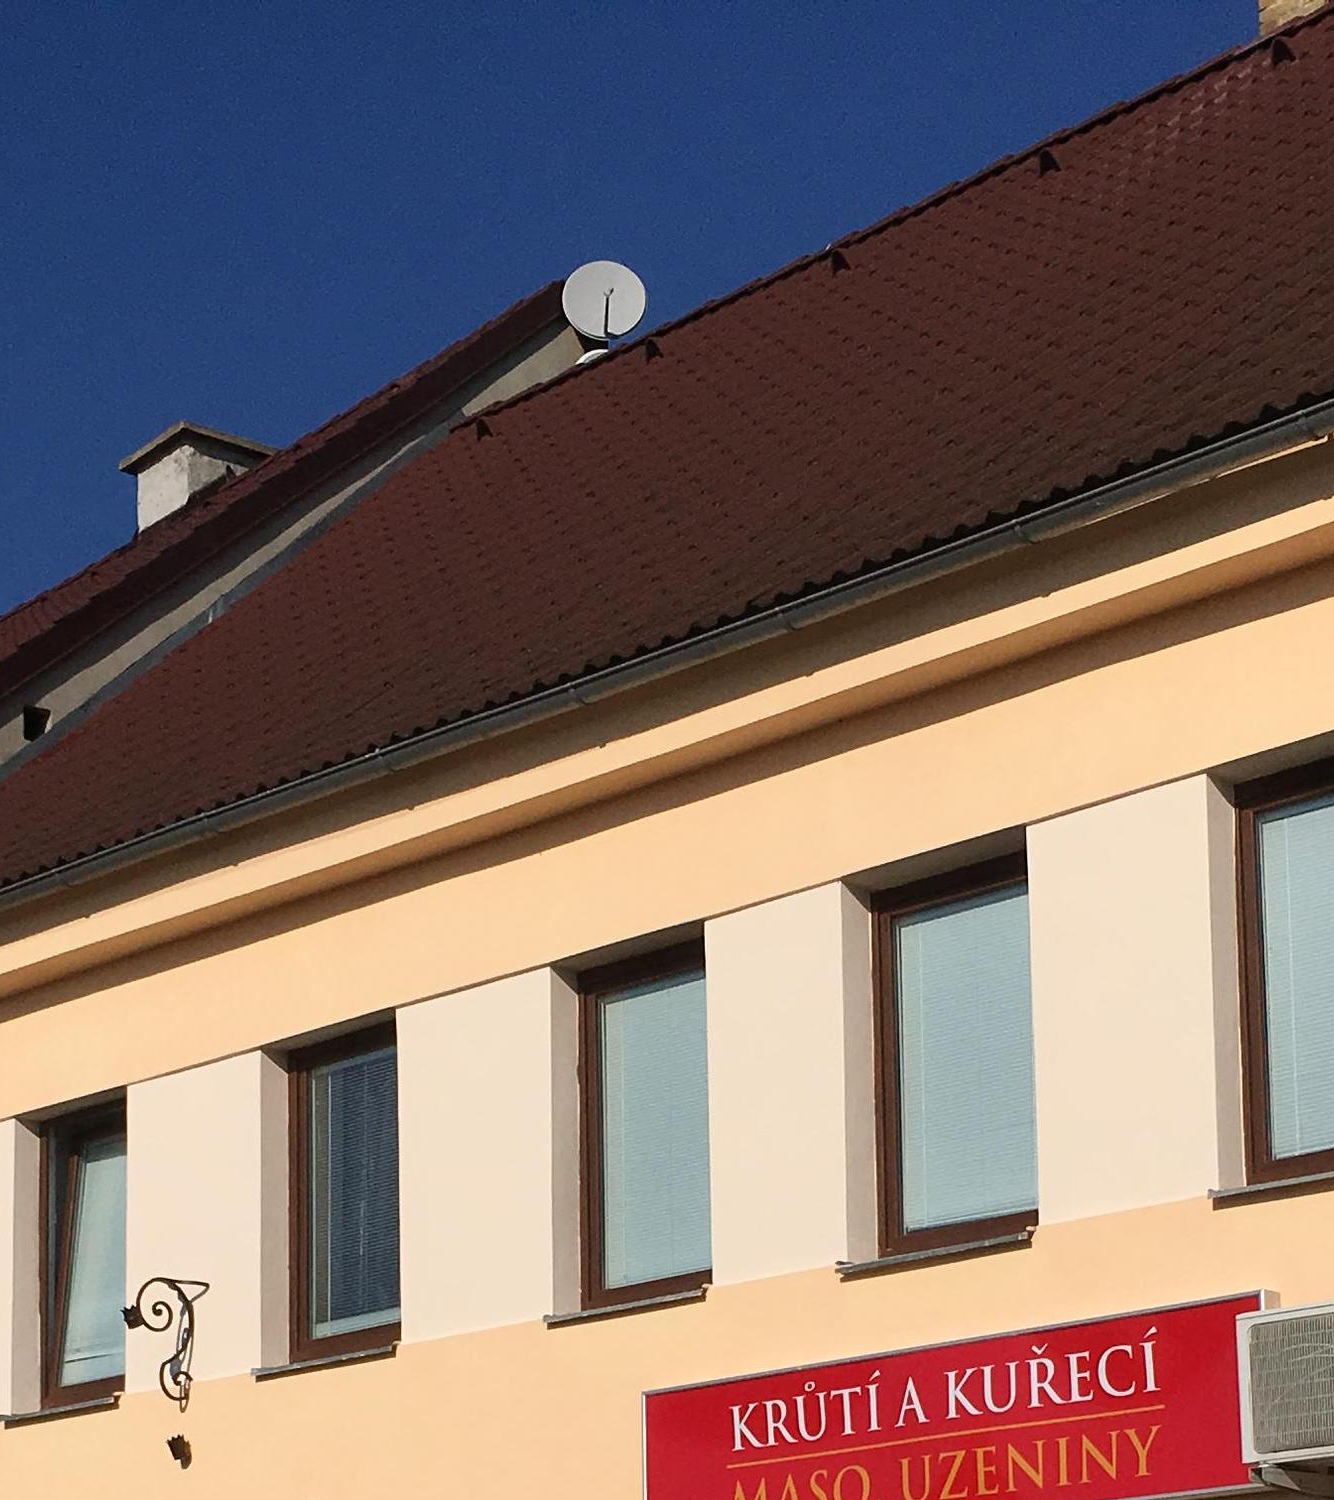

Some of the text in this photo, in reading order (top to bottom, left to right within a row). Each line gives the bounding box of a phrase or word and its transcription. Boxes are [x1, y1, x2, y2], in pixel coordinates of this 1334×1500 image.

[729, 1326, 1162, 1452] KRŮTÍ A KUŘECÍ
